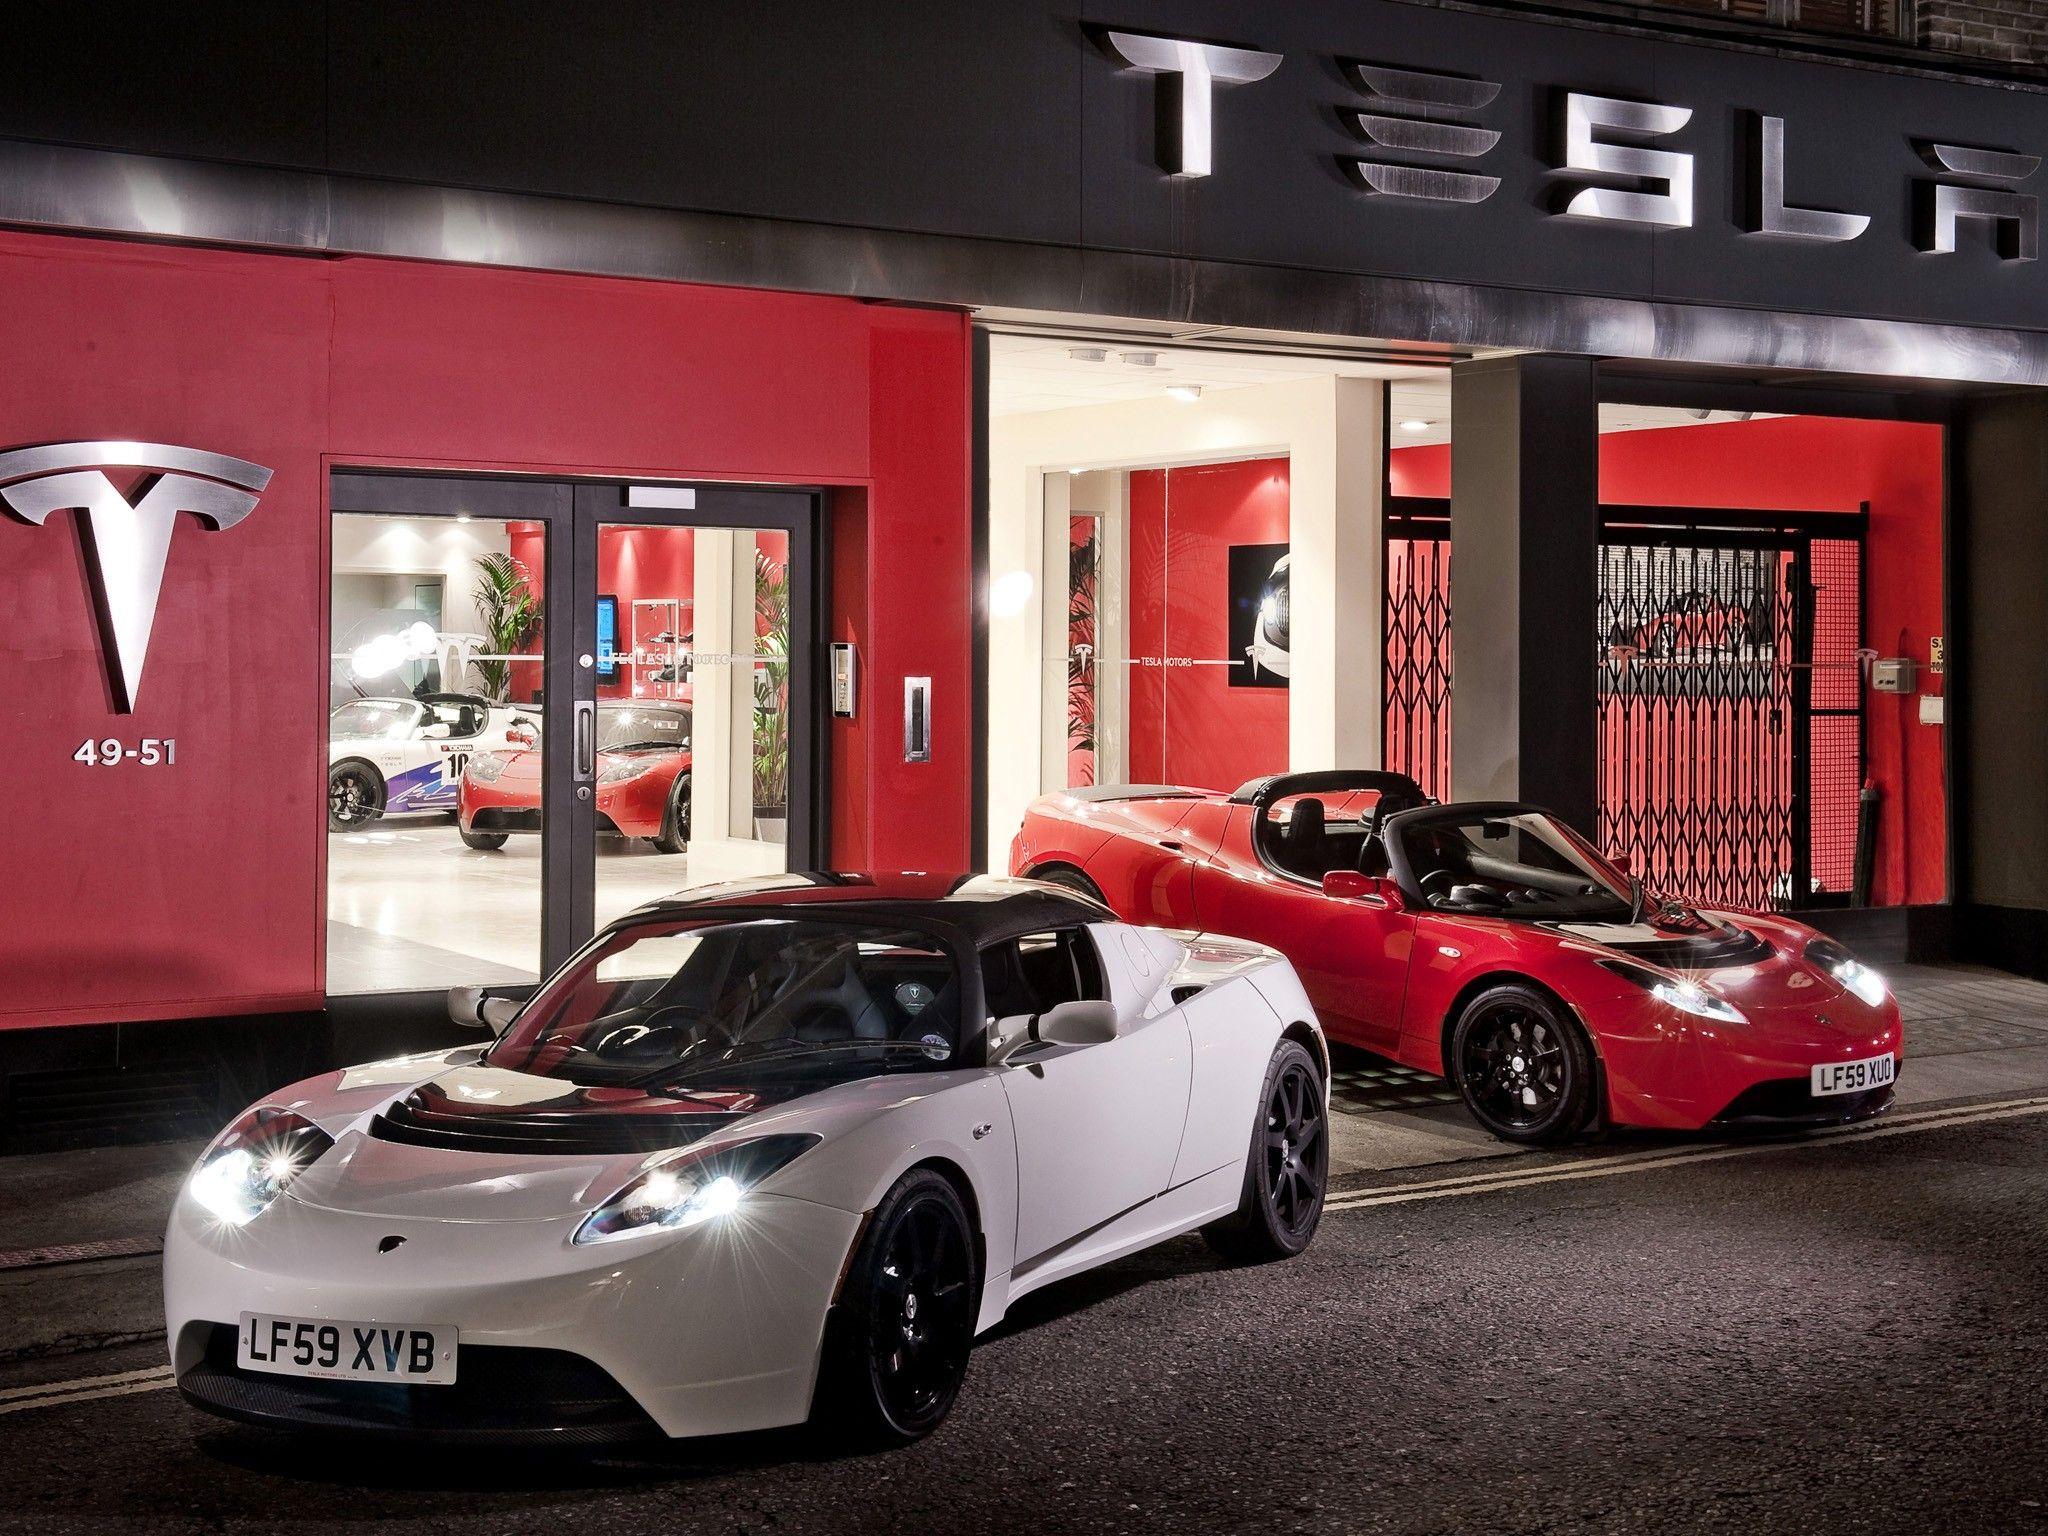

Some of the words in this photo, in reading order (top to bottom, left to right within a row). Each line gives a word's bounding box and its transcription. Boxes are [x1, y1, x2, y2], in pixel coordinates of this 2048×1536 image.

[1107, 30, 2043, 262] TESLA
[1141, 656, 1163, 667] TESLA
[1163, 656, 1193, 667] MOTORS
[73, 738, 177, 767] 49-51
[1821, 1063, 1865, 1092] LF59
[1868, 1057, 1891, 1085] XUO
[249, 1317, 341, 1369] LF59
[351, 1327, 435, 1374] XVB
